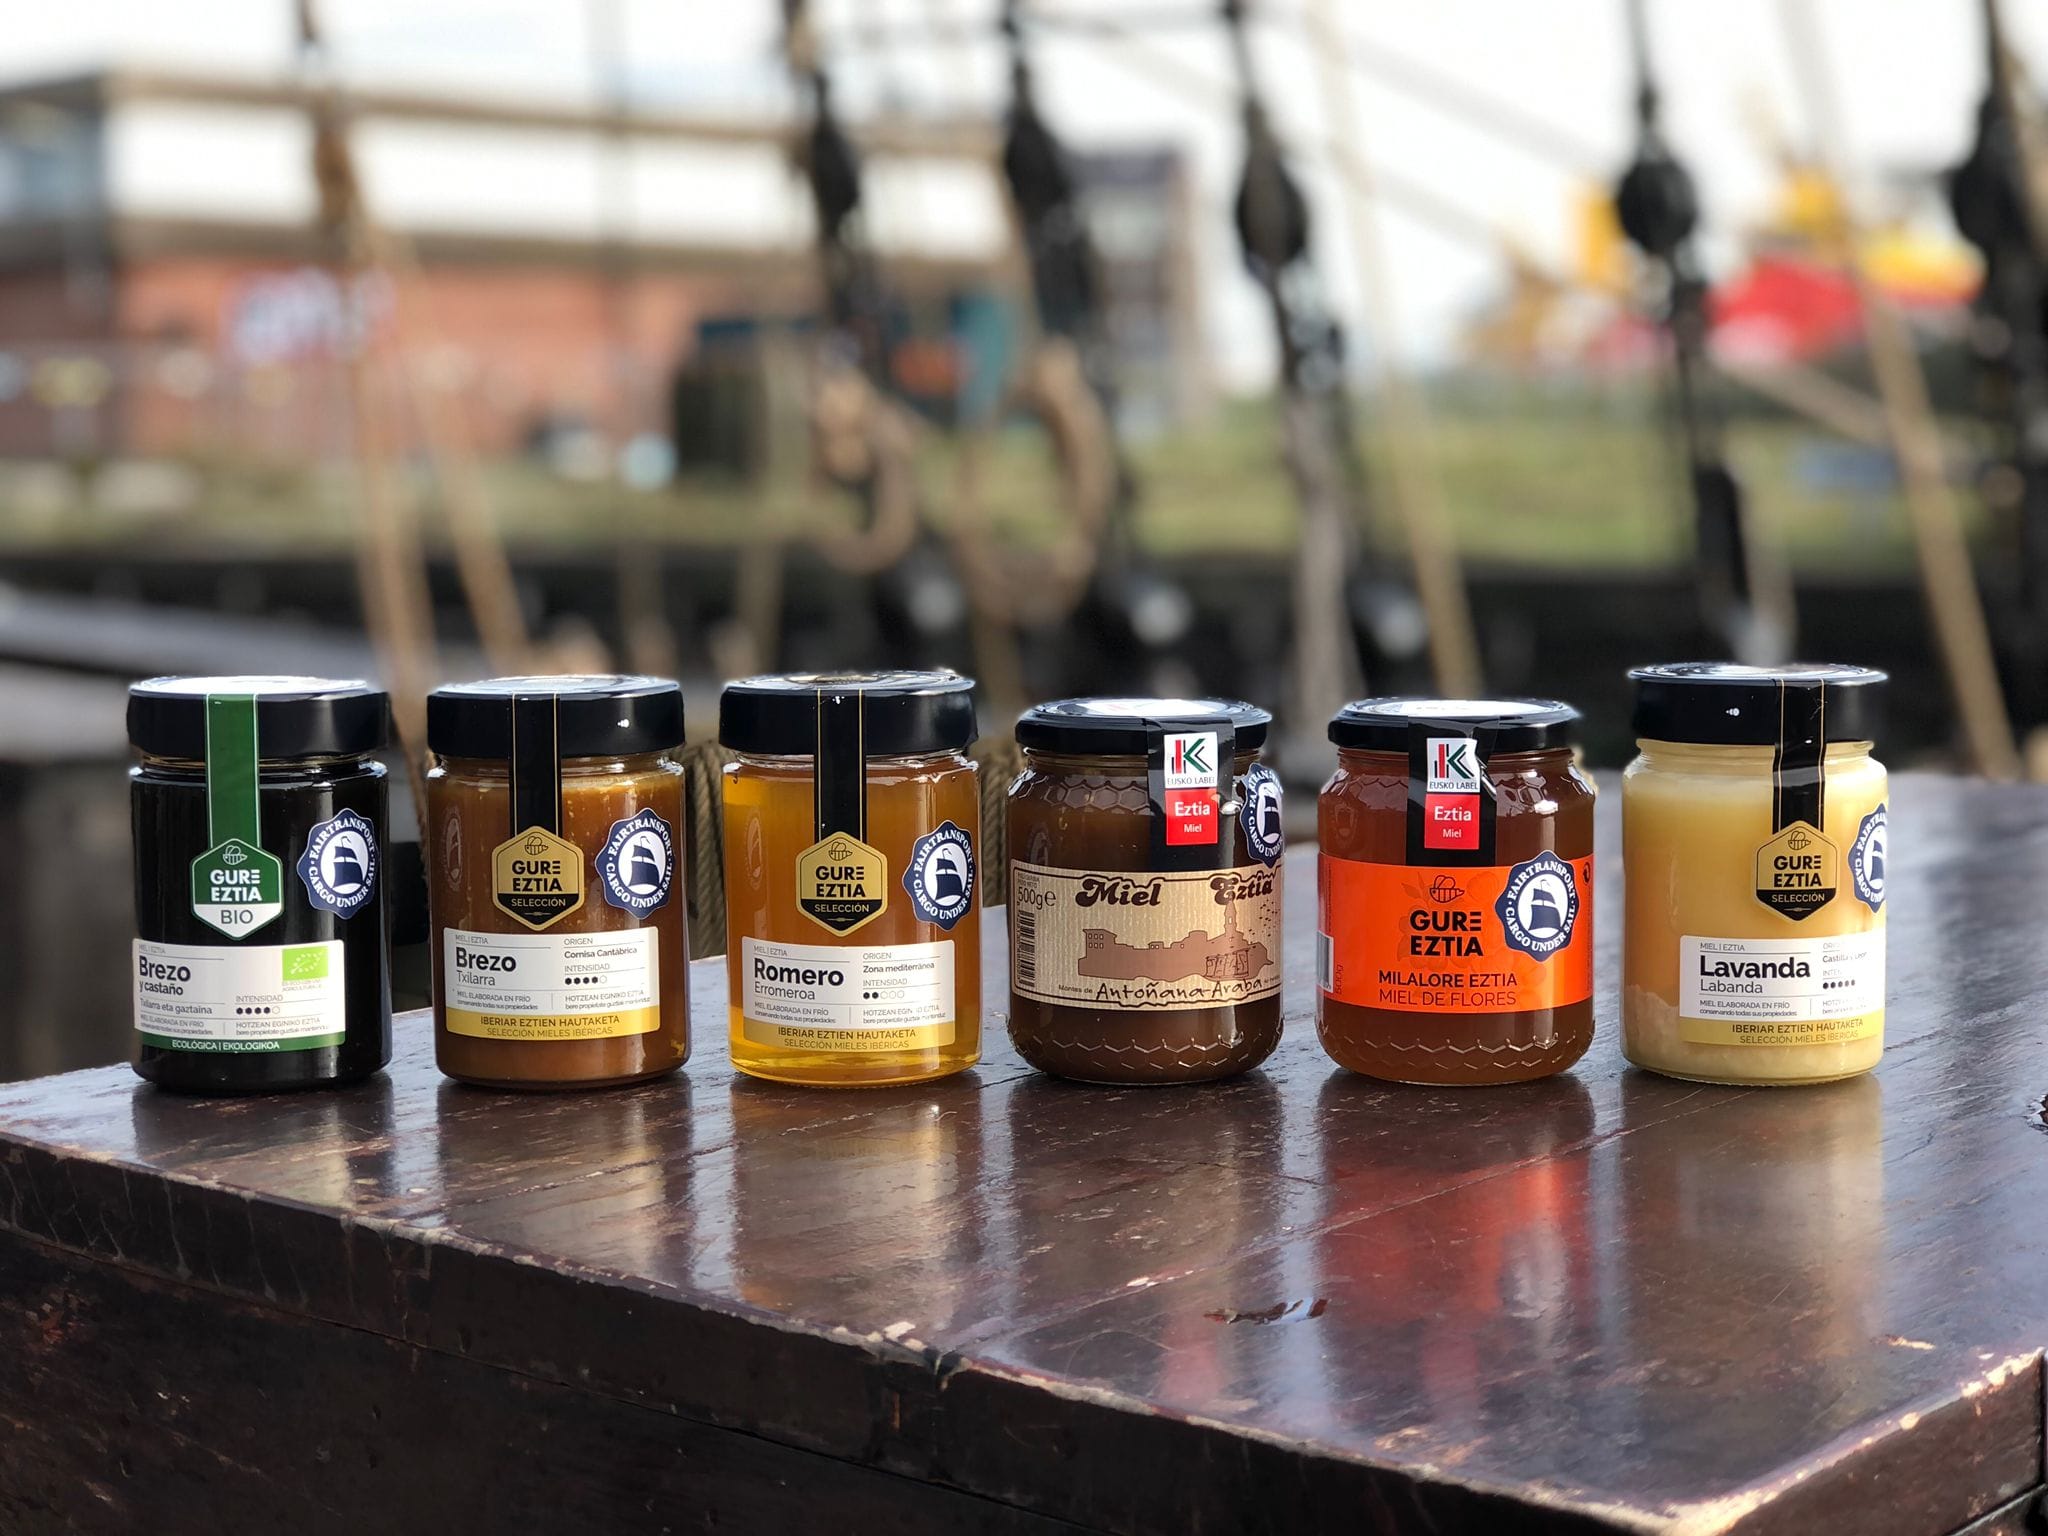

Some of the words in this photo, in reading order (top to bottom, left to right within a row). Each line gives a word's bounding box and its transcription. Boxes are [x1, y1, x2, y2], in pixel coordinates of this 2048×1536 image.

[1167, 776, 1193, 785] EUSKO
[1429, 781, 1455, 790] EUSKO
[1456, 781, 1478, 790] LABEL
[1174, 800, 1211, 817] Eztia
[1434, 805, 1472, 822] Eztia
[1183, 823, 1202, 833] Miel
[1248, 815, 1265, 854] CARGO
[1442, 828, 1462, 838] Miel
[309, 817, 375, 860] FAIRTRANSPORT
[608, 817, 673, 857] FAIRTRANSPORT
[913, 829, 974, 873] FAIRTRANSPORT
[511, 860, 561, 875] GURE
[1774, 855, 1822, 871] GURE
[210, 869, 261, 885] GURE
[815, 865, 865, 880] GURE
[1773, 872, 1823, 888] EZTIA
[1855, 857, 1871, 898] CARGO
[308, 866, 336, 904] CARGO
[336, 886, 369, 908] UNDER
[365, 858, 376, 886] SAIL
[512, 877, 563, 892] EZTIA
[606, 862, 631, 903] CARGO
[631, 889, 665, 909] UNDER
[662, 862, 673, 890] SAIL
[1507, 860, 1576, 901] FAIRTRANSPORT
[210, 886, 263, 902] EZTIA
[816, 883, 867, 898] EZTIA
[913, 879, 939, 917] CARGO
[939, 897, 968, 920] UNDER
[964, 868, 974, 898] SAIL
[1074, 878, 1162, 907] Miel
[1209, 876, 1274, 905] Eztia
[1771, 891, 1825, 903] SELECCIÓN
[511, 897, 566, 907] SELECCIÓN
[814, 902, 870, 913] SELECCIÓN
[220, 909, 254, 925] BIO
[1409, 909, 1482, 932] GURE
[1505, 907, 1531, 947] CARGO
[1531, 931, 1567, 952] UNDER
[1563, 904, 1575, 933] SAIL
[471, 936, 489, 945] EZTIA
[563, 938, 593, 946] ORIGEN
[1410, 935, 1484, 957] EZTIA
[1700, 942, 1718, 951] MIEL
[1722, 943, 1745, 951] EZTIA
[596, 947, 638, 957] Cantábrica
[769, 946, 788, 956] EZTIA
[862, 952, 892, 960] ORIGEN
[455, 946, 517, 972] Brezo
[139, 954, 191, 982] Brezo
[564, 963, 610, 973] INTENSIDAD
[754, 957, 844, 986] Romero
[863, 965, 884, 973] Zona
[885, 962, 935, 973] mediterránea
[1700, 955, 1811, 979] Lavanda
[456, 969, 496, 986] Txilarra
[862, 978, 908, 987] INTENSIDAD
[1378, 969, 1464, 988] MILALORE
[1469, 973, 1518, 988] EZTIA
[139, 980, 144, 993] y
[143, 981, 184, 996] castaño
[754, 981, 816, 1000] Erromeroa
[1700, 978, 1763, 994] Labanda
[235, 993, 284, 1003] INTENSIDAD
[469, 992, 503, 1002] ELABORADA
[504, 995, 514, 1003] EN
[565, 993, 599, 1002] HOTZEAN
[1379, 988, 1418, 1005] MIEL
[1422, 991, 1446, 1006] DE
[1450, 991, 1517, 1007] FLORES
[1699, 999, 1716, 1008] MIEL
[1717, 1000, 1760, 1009] ELABORADA
[1773, 1001, 1790, 1009] FRÍO
[161, 1003, 174, 1012] eta
[174, 1005, 213, 1015] gaztaina
[766, 1003, 801, 1014] ELABORADA
[813, 1007, 829, 1016] FRÍO
[863, 1009, 897, 1017] HOTZEAN
[1699, 1008, 1735, 1017] conservando
[235, 1021, 271, 1029] HOTZEAN
[272, 1019, 301, 1028] EGINIKO
[301, 1016, 321, 1025] EZTIA
[480, 1015, 517, 1027] IBERIAR
[519, 1018, 556, 1028] EZTIEN
[559, 1015, 620, 1027] HAUTAKETA
[1732, 1023, 1774, 1034] IBERIAR
[1777, 1024, 1814, 1034] EZTIEN
[1816, 1018, 1863, 1032] HAUTAKETA
[537, 1028, 571, 1038] MIELES
[778, 1026, 815, 1038] IBERIAR
[817, 1030, 854, 1040] EZTIEN
[856, 1028, 916, 1040] HAUTAKETA
[1795, 1033, 1826, 1043] MIELES
[171, 1039, 217, 1050] ECOLÓGICA
[222, 1041, 280, 1051] EKOLOGIKOA
[834, 1040, 868, 1051] MIELES
